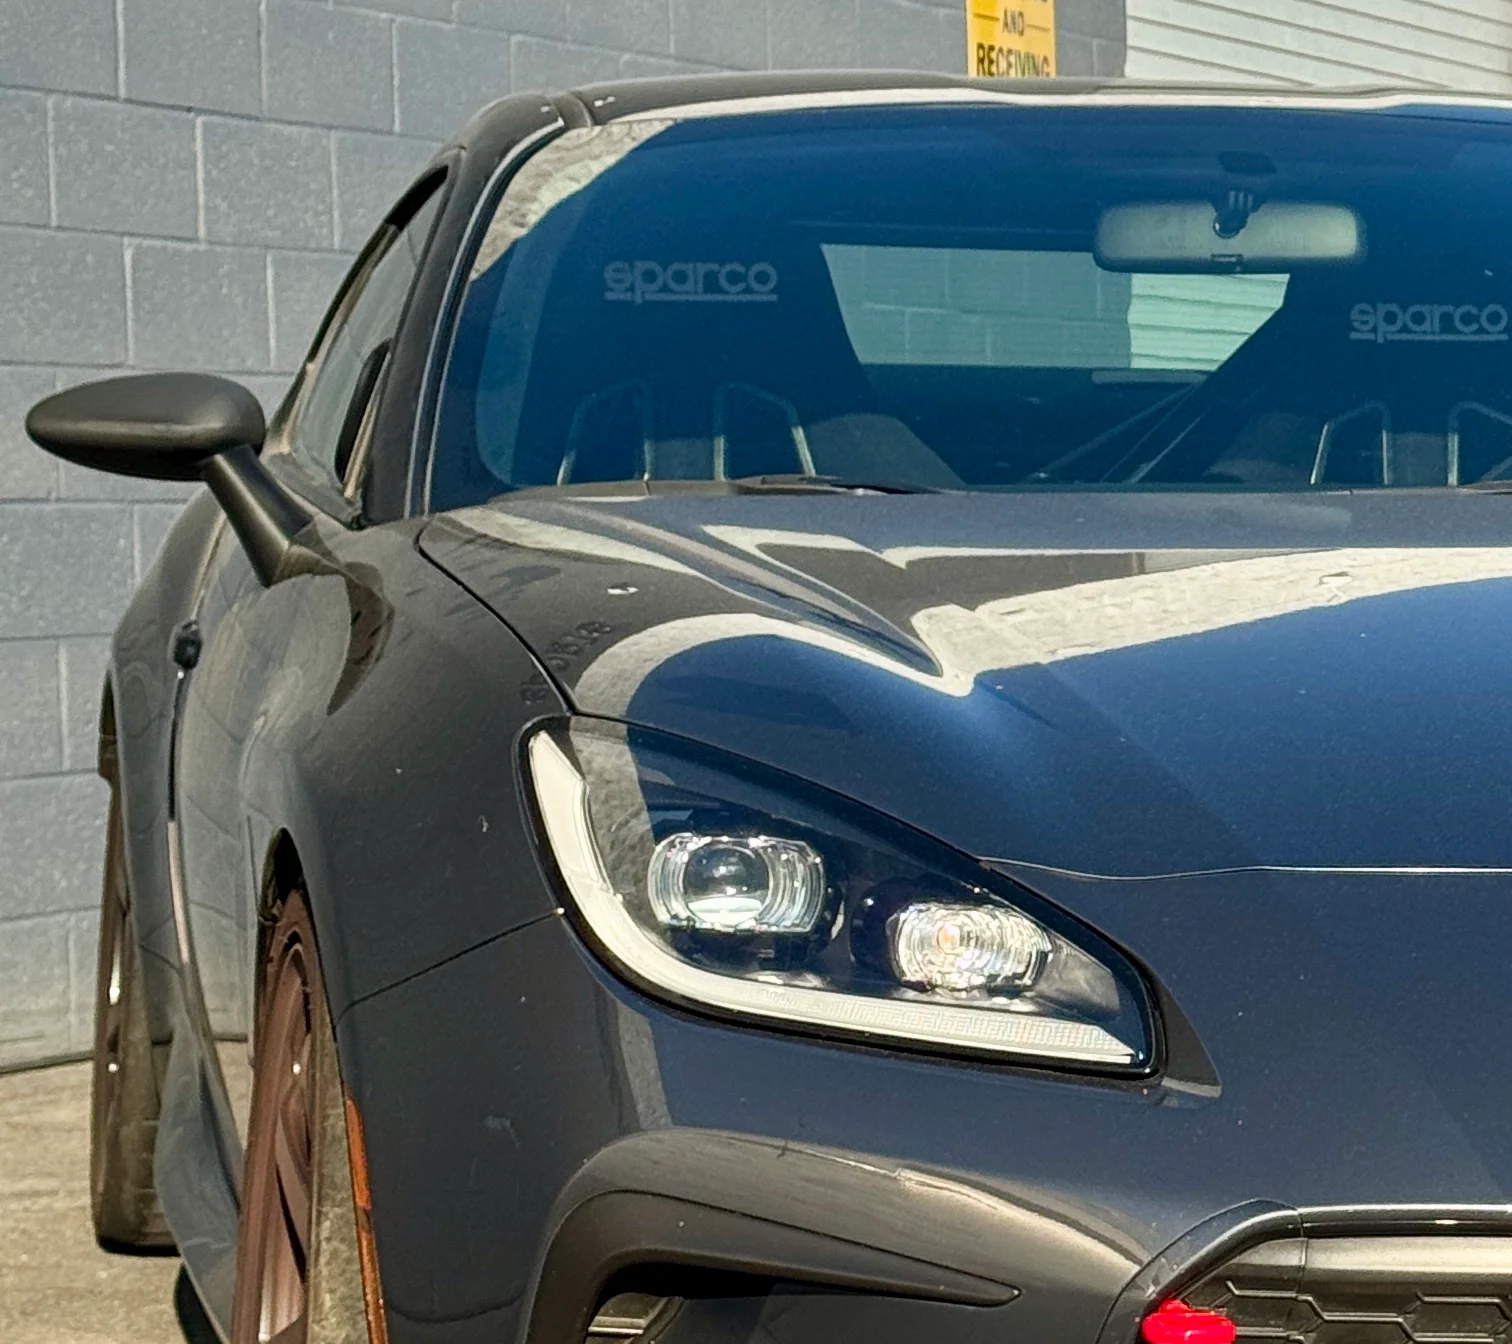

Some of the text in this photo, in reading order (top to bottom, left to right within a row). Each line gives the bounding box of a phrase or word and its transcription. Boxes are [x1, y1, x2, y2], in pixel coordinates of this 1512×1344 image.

[1002, 7, 1025, 37] AND
[604, 260, 778, 305] sparco
[1349, 302, 1509, 344] sparco
